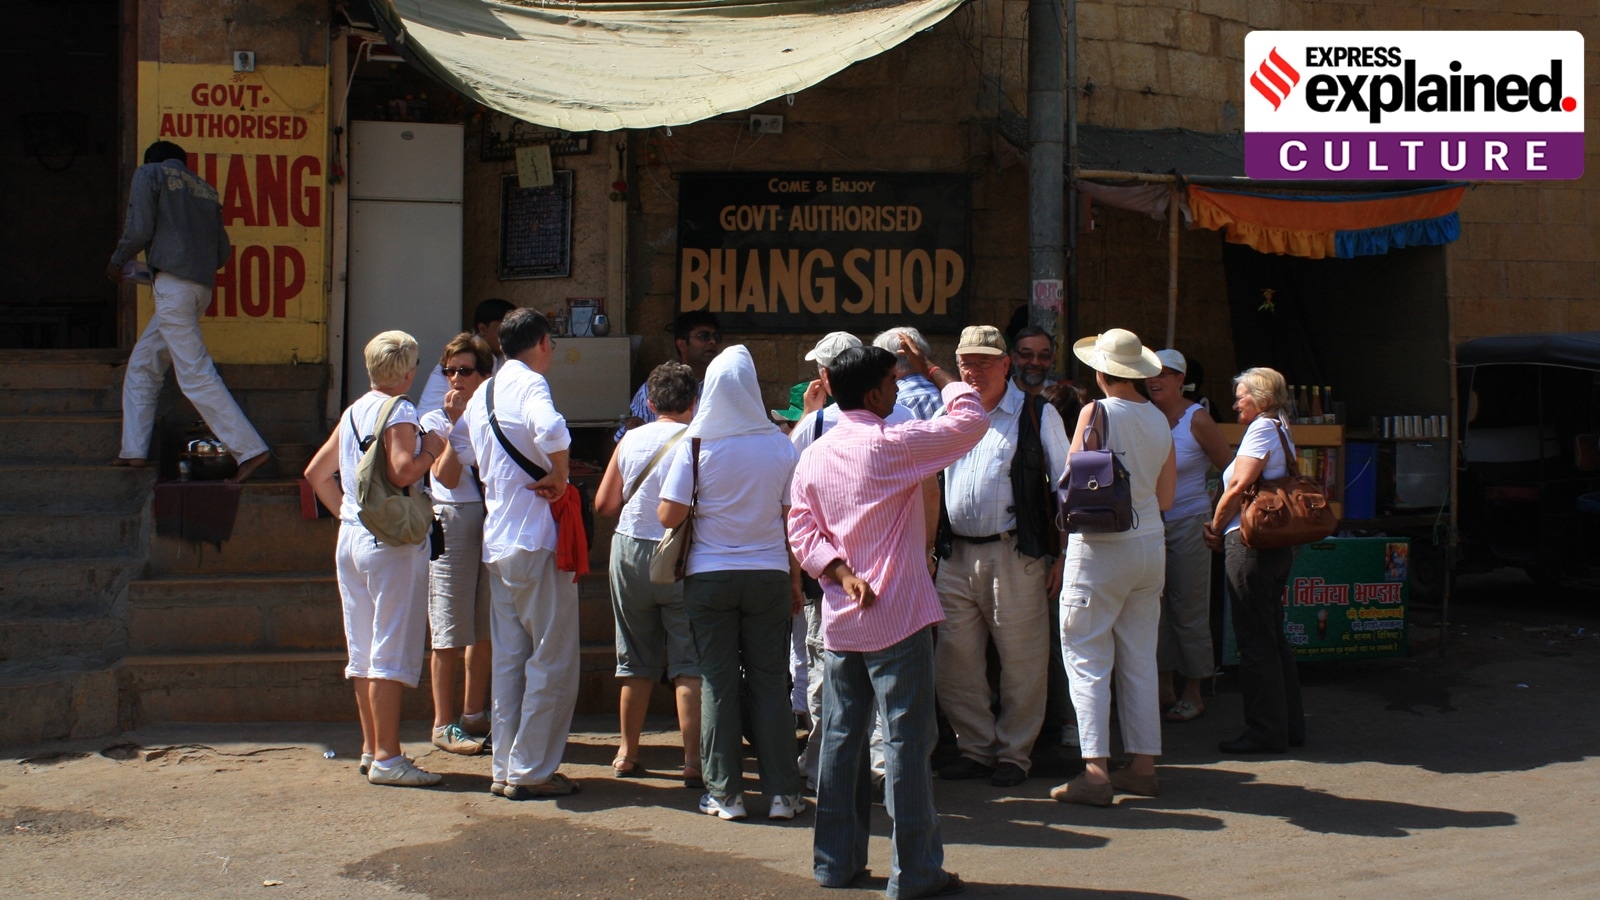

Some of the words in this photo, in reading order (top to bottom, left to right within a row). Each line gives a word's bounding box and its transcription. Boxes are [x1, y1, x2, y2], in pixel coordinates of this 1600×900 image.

[191, 83, 270, 108] GOVT.
[159, 113, 308, 140] AUTHORISED
[186, 152, 322, 227] ANG
[816, 180, 828, 193] &
[788, 205, 923, 232] AUTHORISED
[204, 244, 306, 318] HOP
[680, 247, 836, 314] BHANG
[841, 248, 965, 315] SHOP
[1294, 577, 1349, 606] विजिया
[1354, 582, 1403, 604] भण्डार
